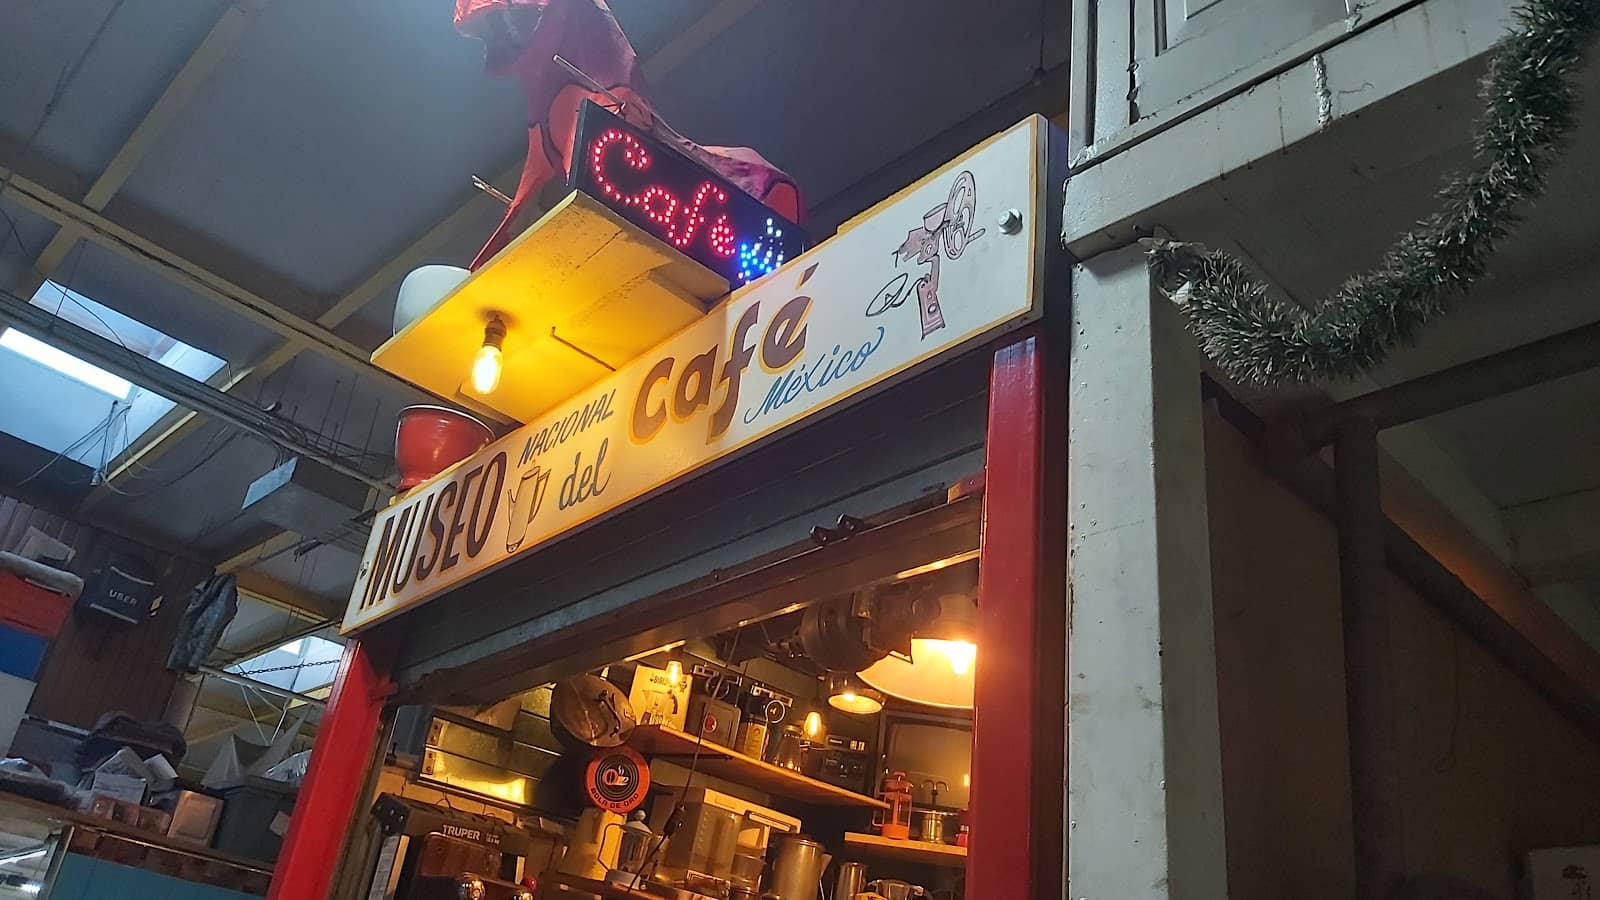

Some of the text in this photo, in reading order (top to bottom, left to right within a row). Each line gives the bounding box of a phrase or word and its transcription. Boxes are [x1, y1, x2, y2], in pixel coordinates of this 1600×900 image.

[593, 130, 736, 256] Café
[631, 262, 819, 442] café
[743, 326, 885, 424] México
[518, 388, 617, 466] NACIONAL
[559, 437, 611, 511] del
[358, 451, 508, 610] MUSEO
[109, 589, 137, 606] UBER
[442, 824, 481, 841] TRUPER
